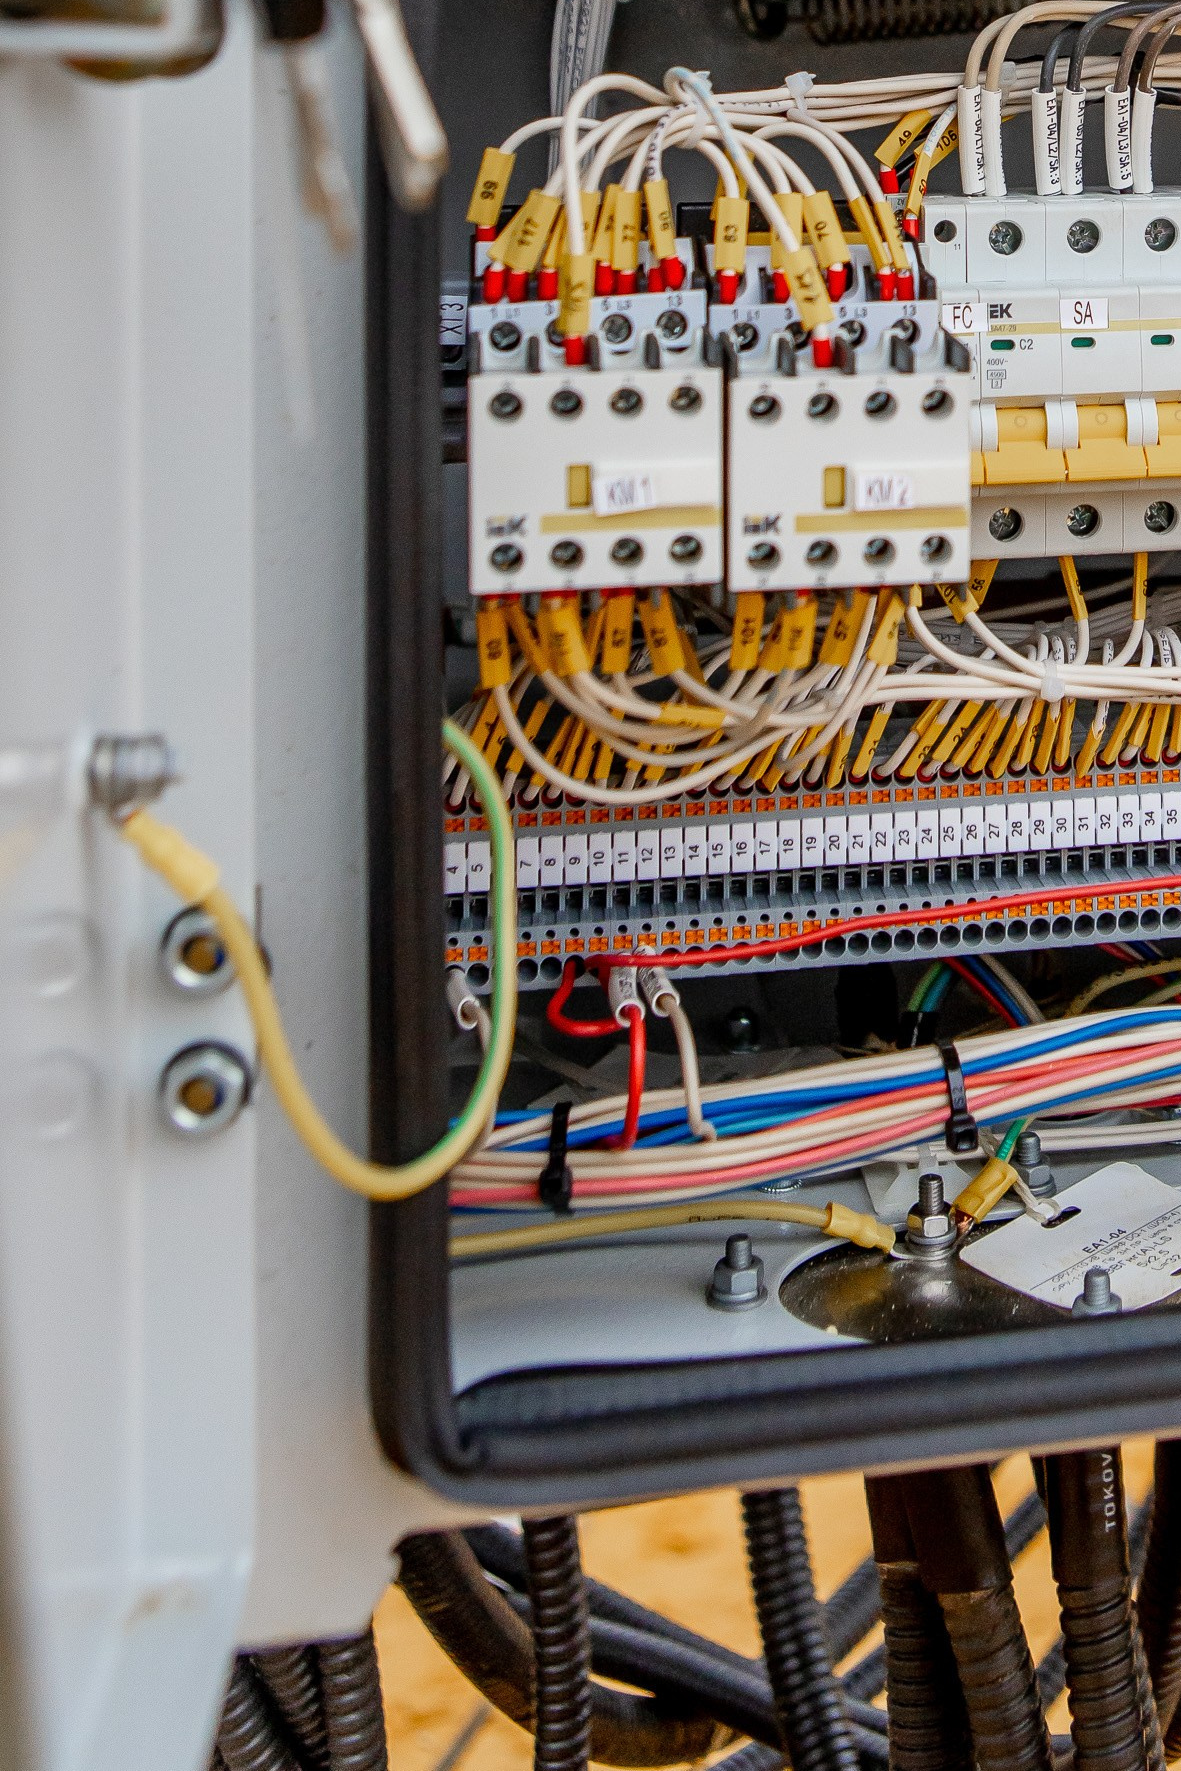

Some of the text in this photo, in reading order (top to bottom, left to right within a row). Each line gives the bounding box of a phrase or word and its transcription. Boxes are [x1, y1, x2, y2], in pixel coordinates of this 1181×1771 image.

[898, 130, 912, 146] 49
[937, 130, 957, 151] 106
[1046, 97, 1060, 184] EA1-04/L2/SA:3
[1117, 97, 1132, 181] EA1-04/L3/SA:5
[953, 306, 972, 329] FC
[1073, 301, 1093, 326] SA
[1020, 339, 1033, 350] C2
[1077, 816, 1089, 832] 31
[1122, 812, 1134, 828] 33
[921, 827, 933, 845] 24
[1011, 820, 1023, 838] 28
[828, 834, 841, 852] 20
[875, 831, 887, 848] 22
[617, 852, 629, 865] 11
[663, 845, 676, 862] 13
[711, 842, 724, 859] 15
[519, 859, 532, 869] 7
[568, 856, 581, 866] 9
[1081, 1228, 1129, 1256] EA1-04
[1101, 1452, 1117, 1534] TOKOV
